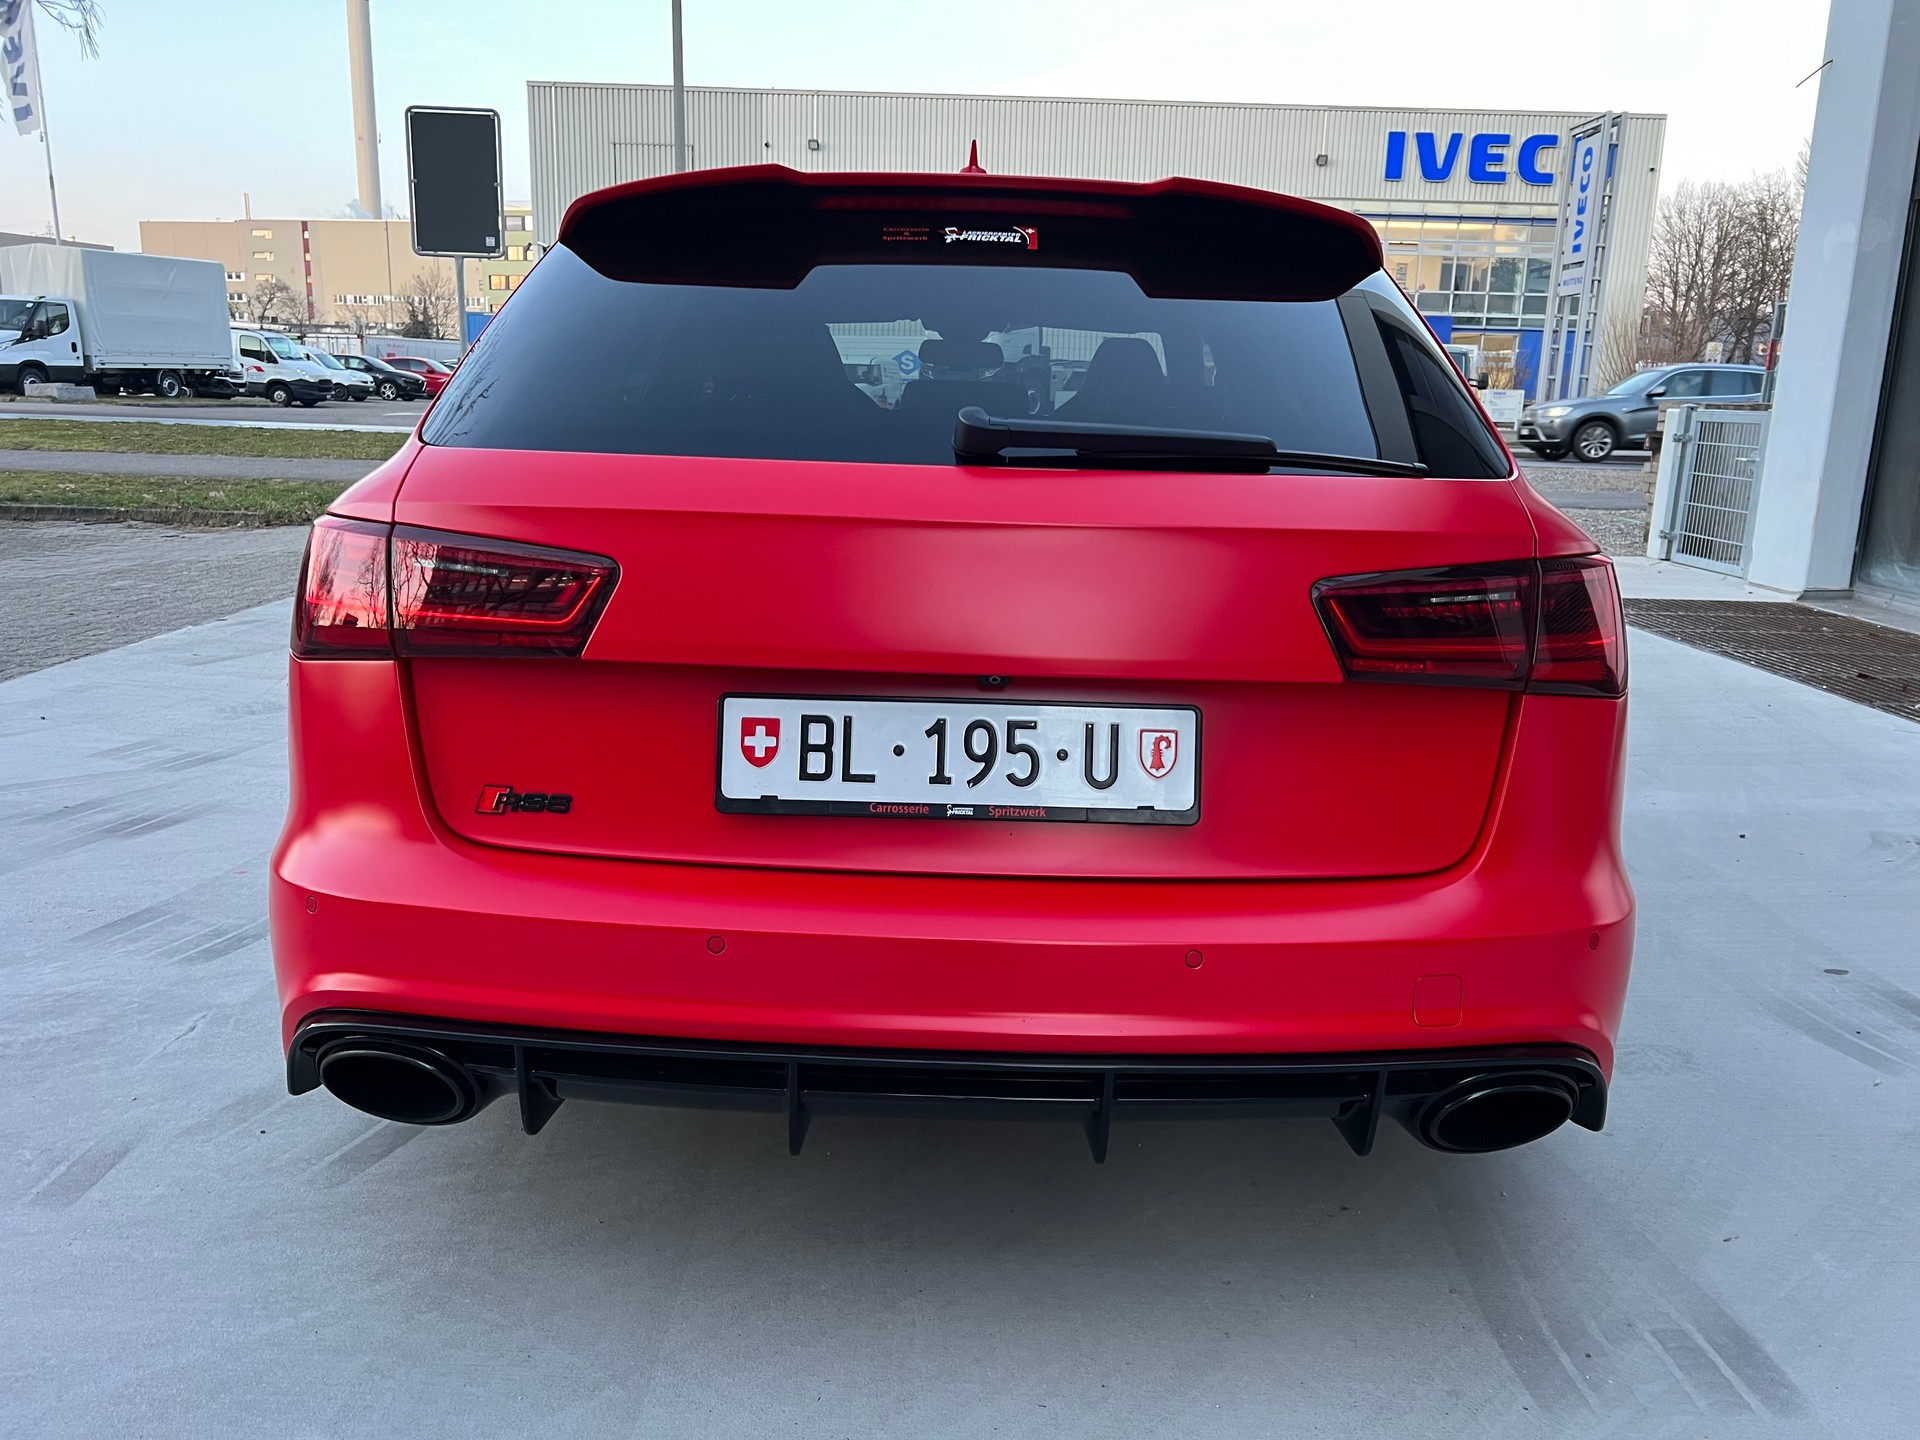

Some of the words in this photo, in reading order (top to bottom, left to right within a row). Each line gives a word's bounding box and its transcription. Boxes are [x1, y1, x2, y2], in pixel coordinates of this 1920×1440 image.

[1384, 131, 1616, 185] IVEC
[1571, 146, 1593, 254] IVECO
[960, 233, 1021, 242] FRICKTAL
[900, 354, 914, 370] S
[489, 792, 573, 815] RS6
[869, 802, 930, 814] Carrosserie
[988, 805, 1046, 818] Spritzwerk
